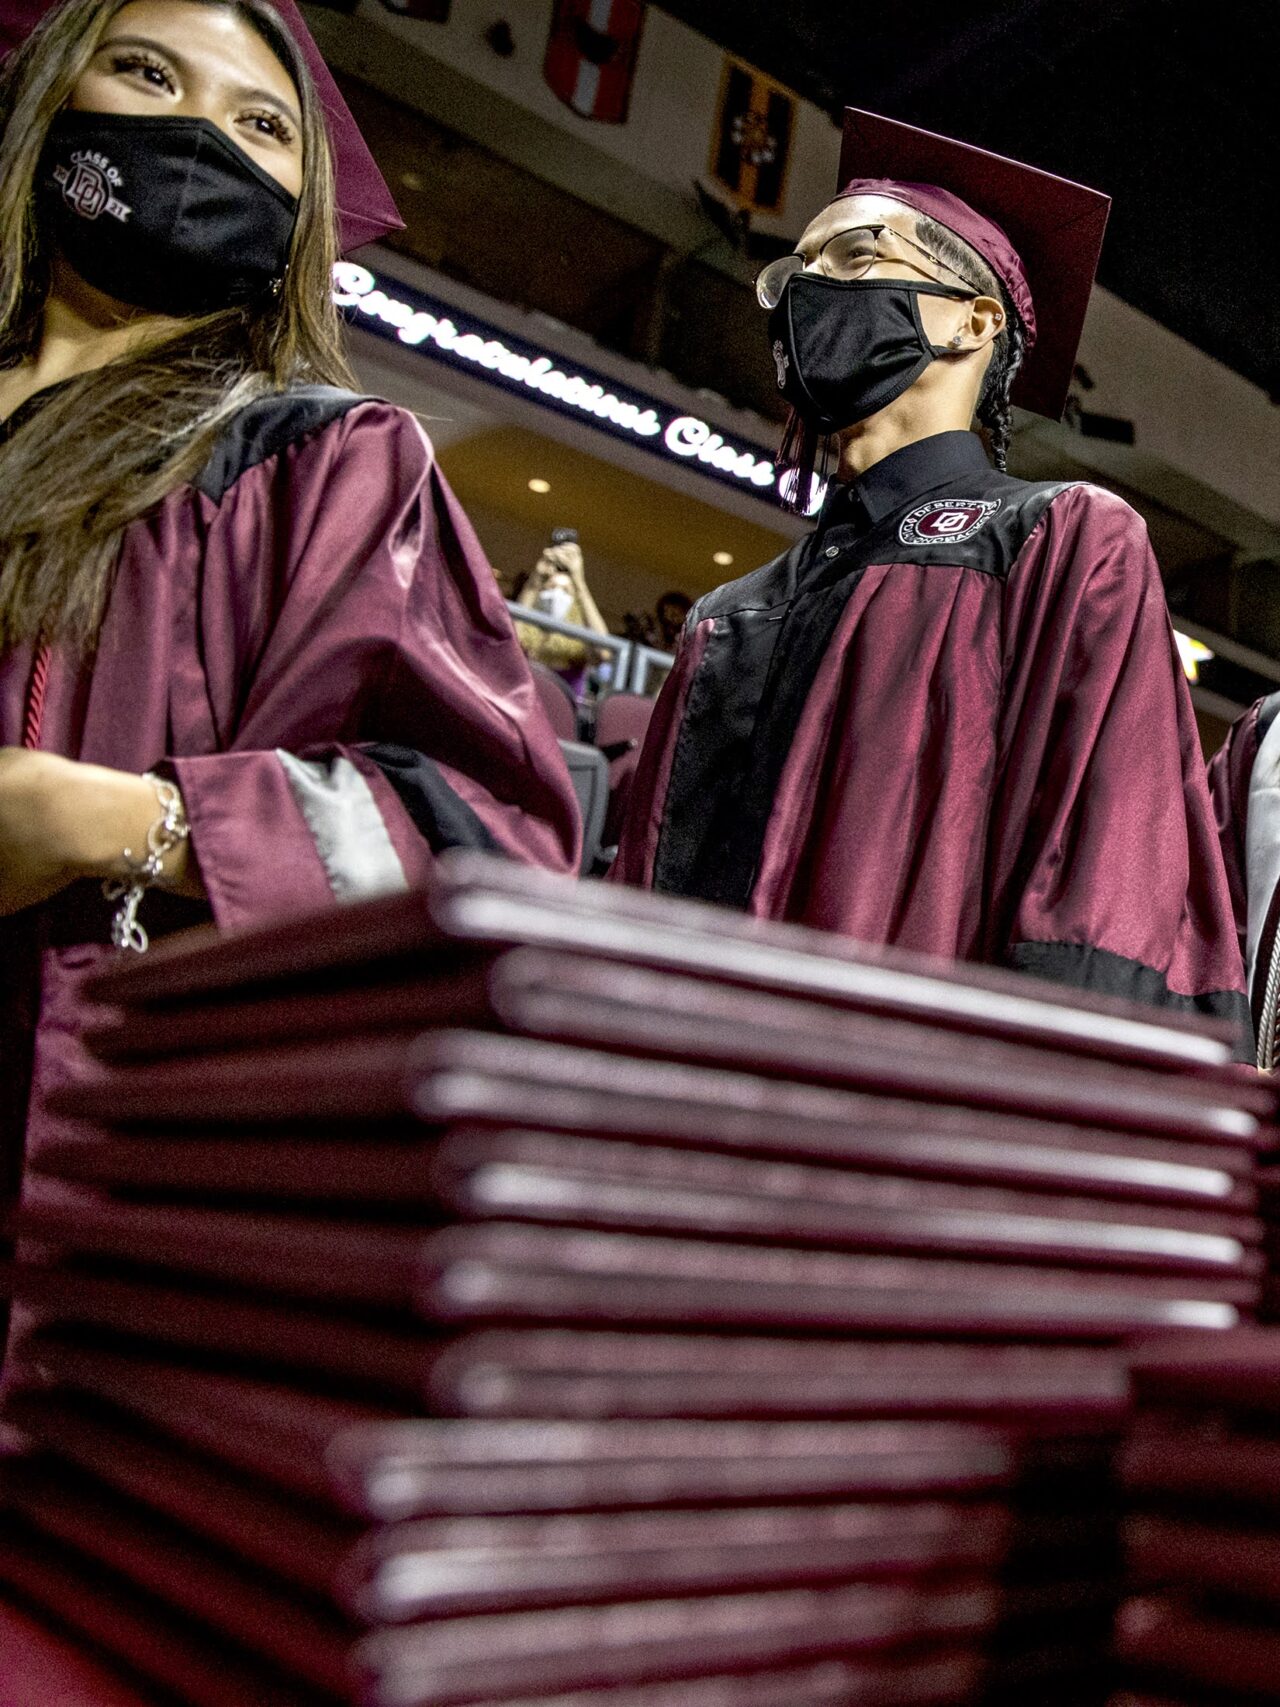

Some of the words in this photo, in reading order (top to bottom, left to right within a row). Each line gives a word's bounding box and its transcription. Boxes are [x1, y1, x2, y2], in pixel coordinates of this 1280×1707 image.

[70, 149, 109, 169] CLASS
[107, 166, 123, 187] OF
[332, 261, 661, 437] Congratulations
[664, 416, 775, 486] Class
